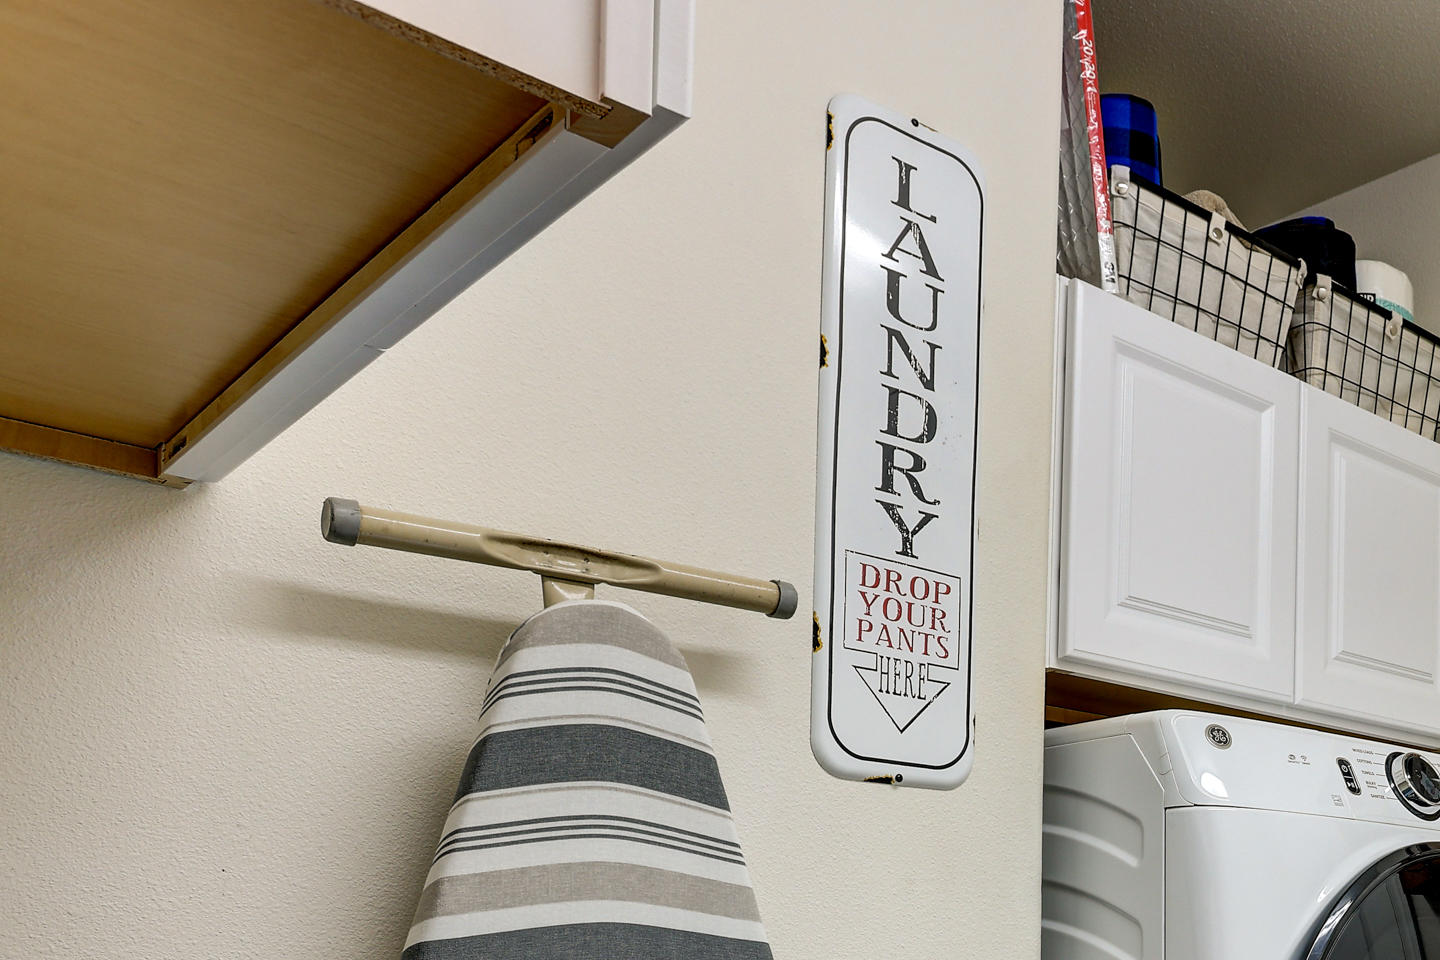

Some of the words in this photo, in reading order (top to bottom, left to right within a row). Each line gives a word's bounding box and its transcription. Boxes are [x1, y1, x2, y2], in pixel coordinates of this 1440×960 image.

[875, 155, 945, 560] LAUNDRY
[858, 562, 951, 605] DROP
[857, 590, 951, 634] YOUR
[855, 617, 950, 659] PANTS
[878, 655, 927, 701] HERE
